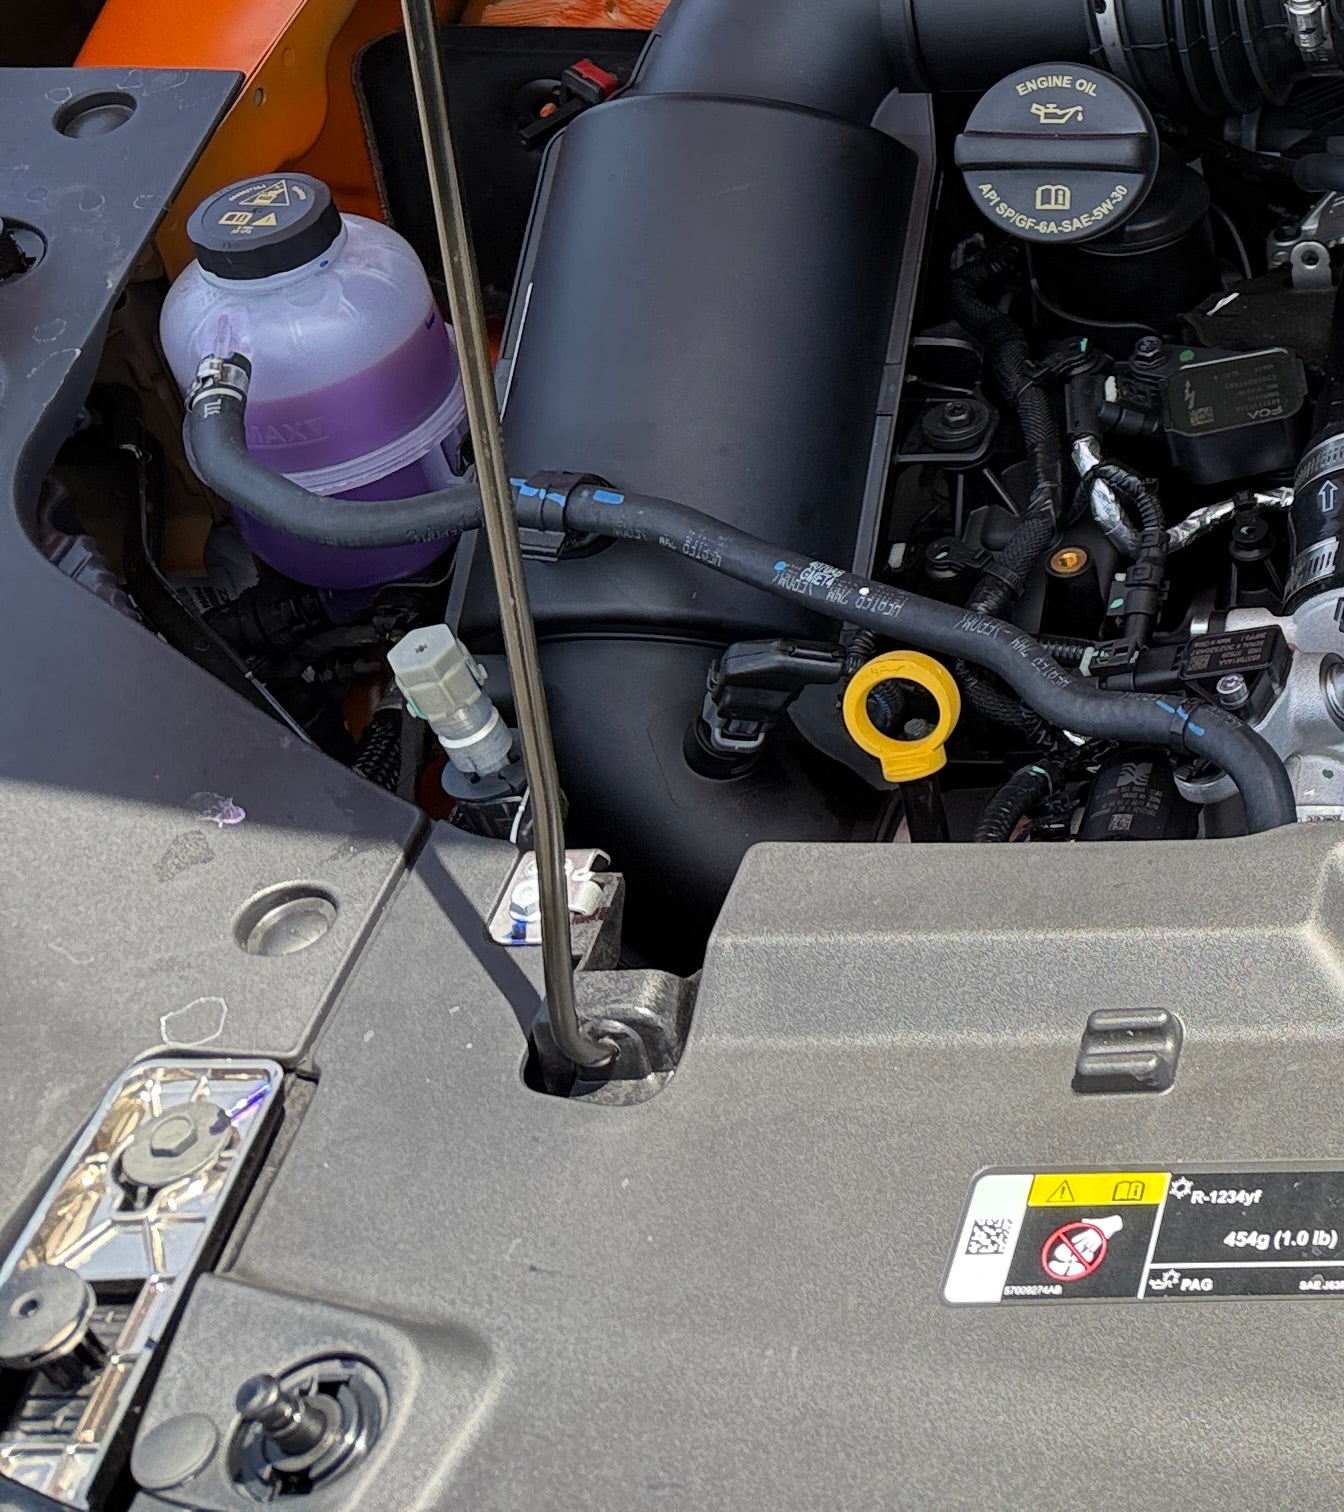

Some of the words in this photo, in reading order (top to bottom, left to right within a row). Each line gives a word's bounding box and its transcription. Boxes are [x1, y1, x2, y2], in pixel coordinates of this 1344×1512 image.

[1016, 76, 1072, 96] ENGINE
[1075, 79, 1098, 97] OIL
[978, 183, 998, 208] API
[1247, 405, 1284, 419] FCA
[247, 422, 307, 444] MAX
[1190, 1189, 1263, 1206] R-1234yf
[1223, 1230, 1271, 1250] 454g
[1274, 1229, 1309, 1250] (1.0
[1312, 1229, 1338, 1249] lb)
[1180, 1278, 1214, 1291] PAG
[1299, 1280, 1322, 1291] SAE
